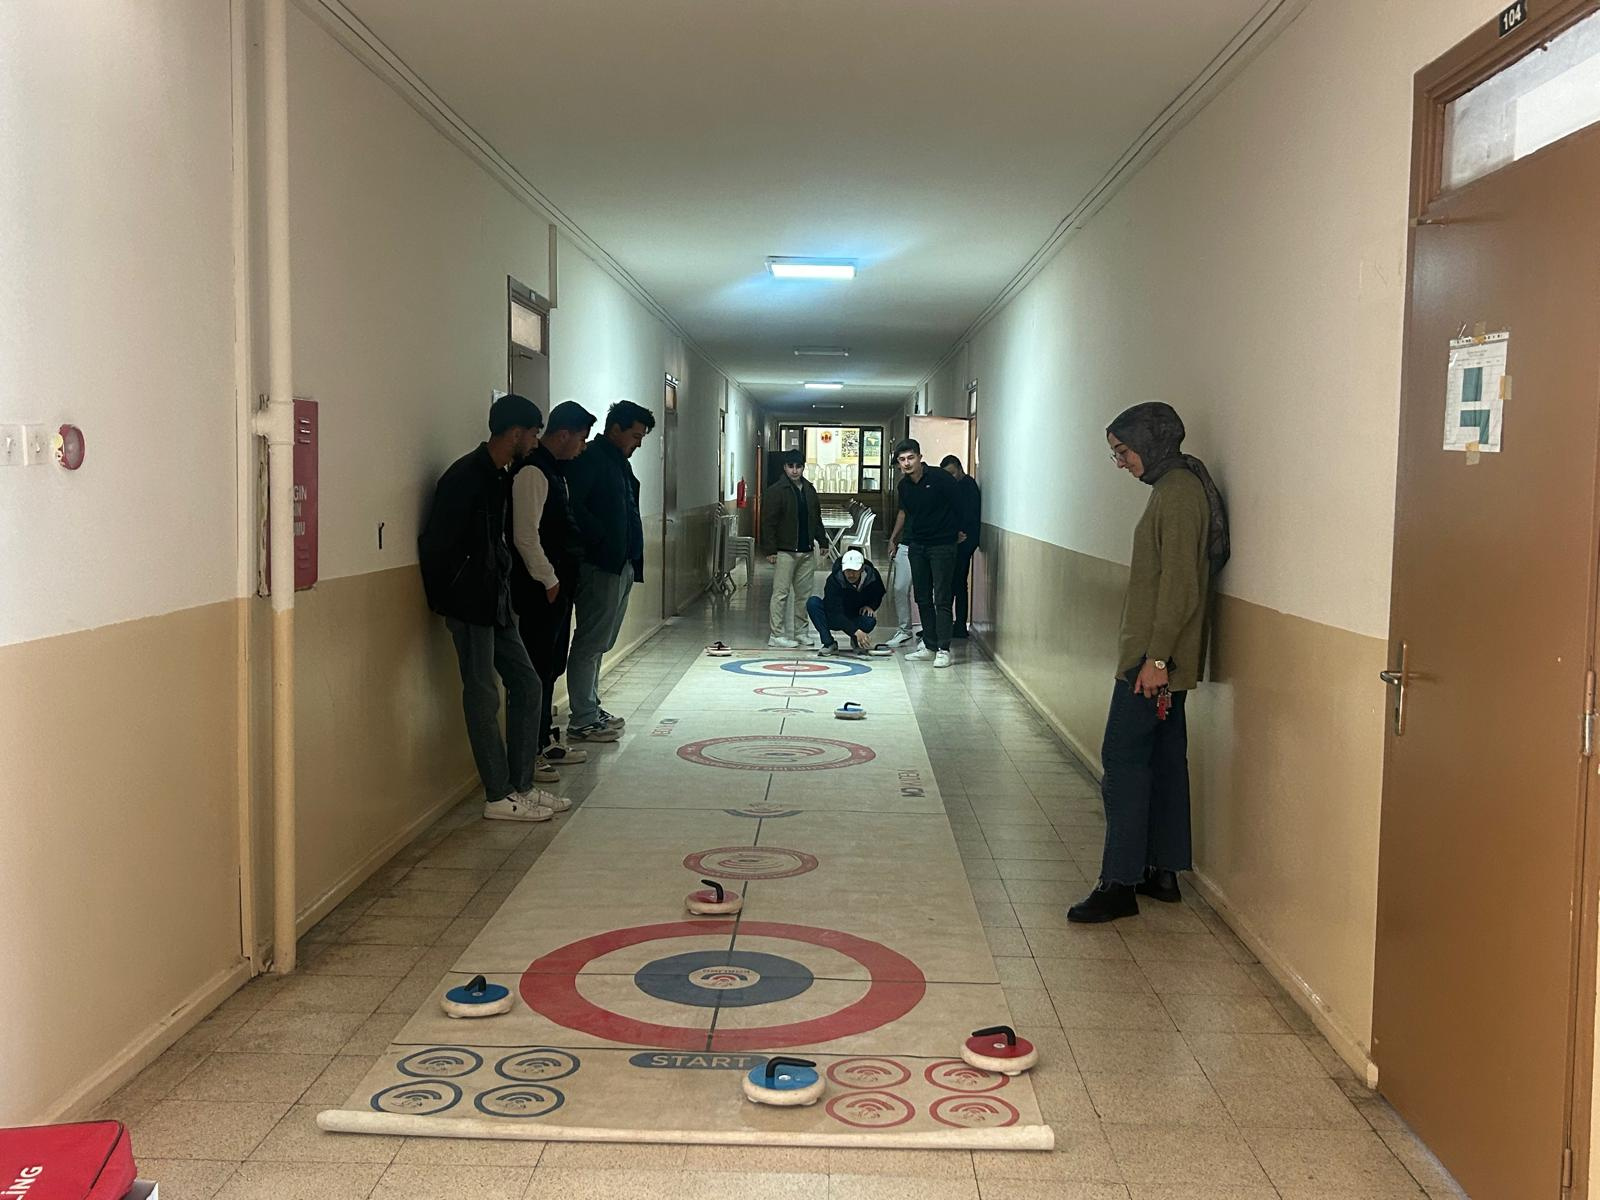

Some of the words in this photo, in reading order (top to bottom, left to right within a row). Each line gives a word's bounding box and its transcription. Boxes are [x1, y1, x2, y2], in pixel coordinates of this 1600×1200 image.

[1503, 4, 1522, 30] 104
[293, 485, 307, 501] GIN
[651, 1055, 751, 1068] START
